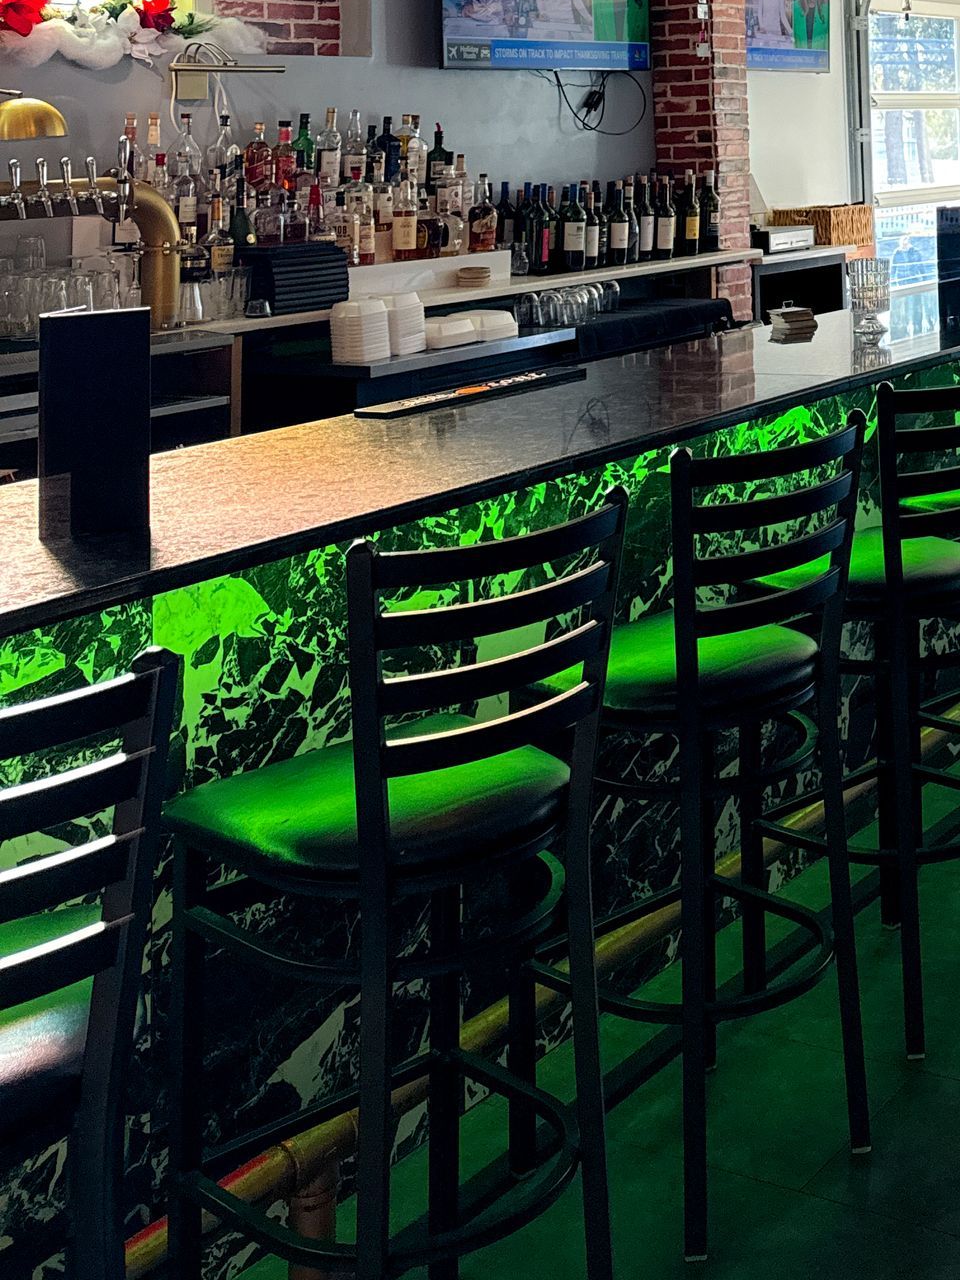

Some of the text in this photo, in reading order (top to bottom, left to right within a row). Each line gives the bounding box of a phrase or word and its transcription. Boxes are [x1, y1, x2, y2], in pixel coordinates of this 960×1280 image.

[495, 47, 518, 59] STORMS
[519, 48, 527, 59] ON
[528, 48, 545, 59] TRACK
[546, 48, 553, 59] TO
[554, 48, 573, 60] IMPACT
